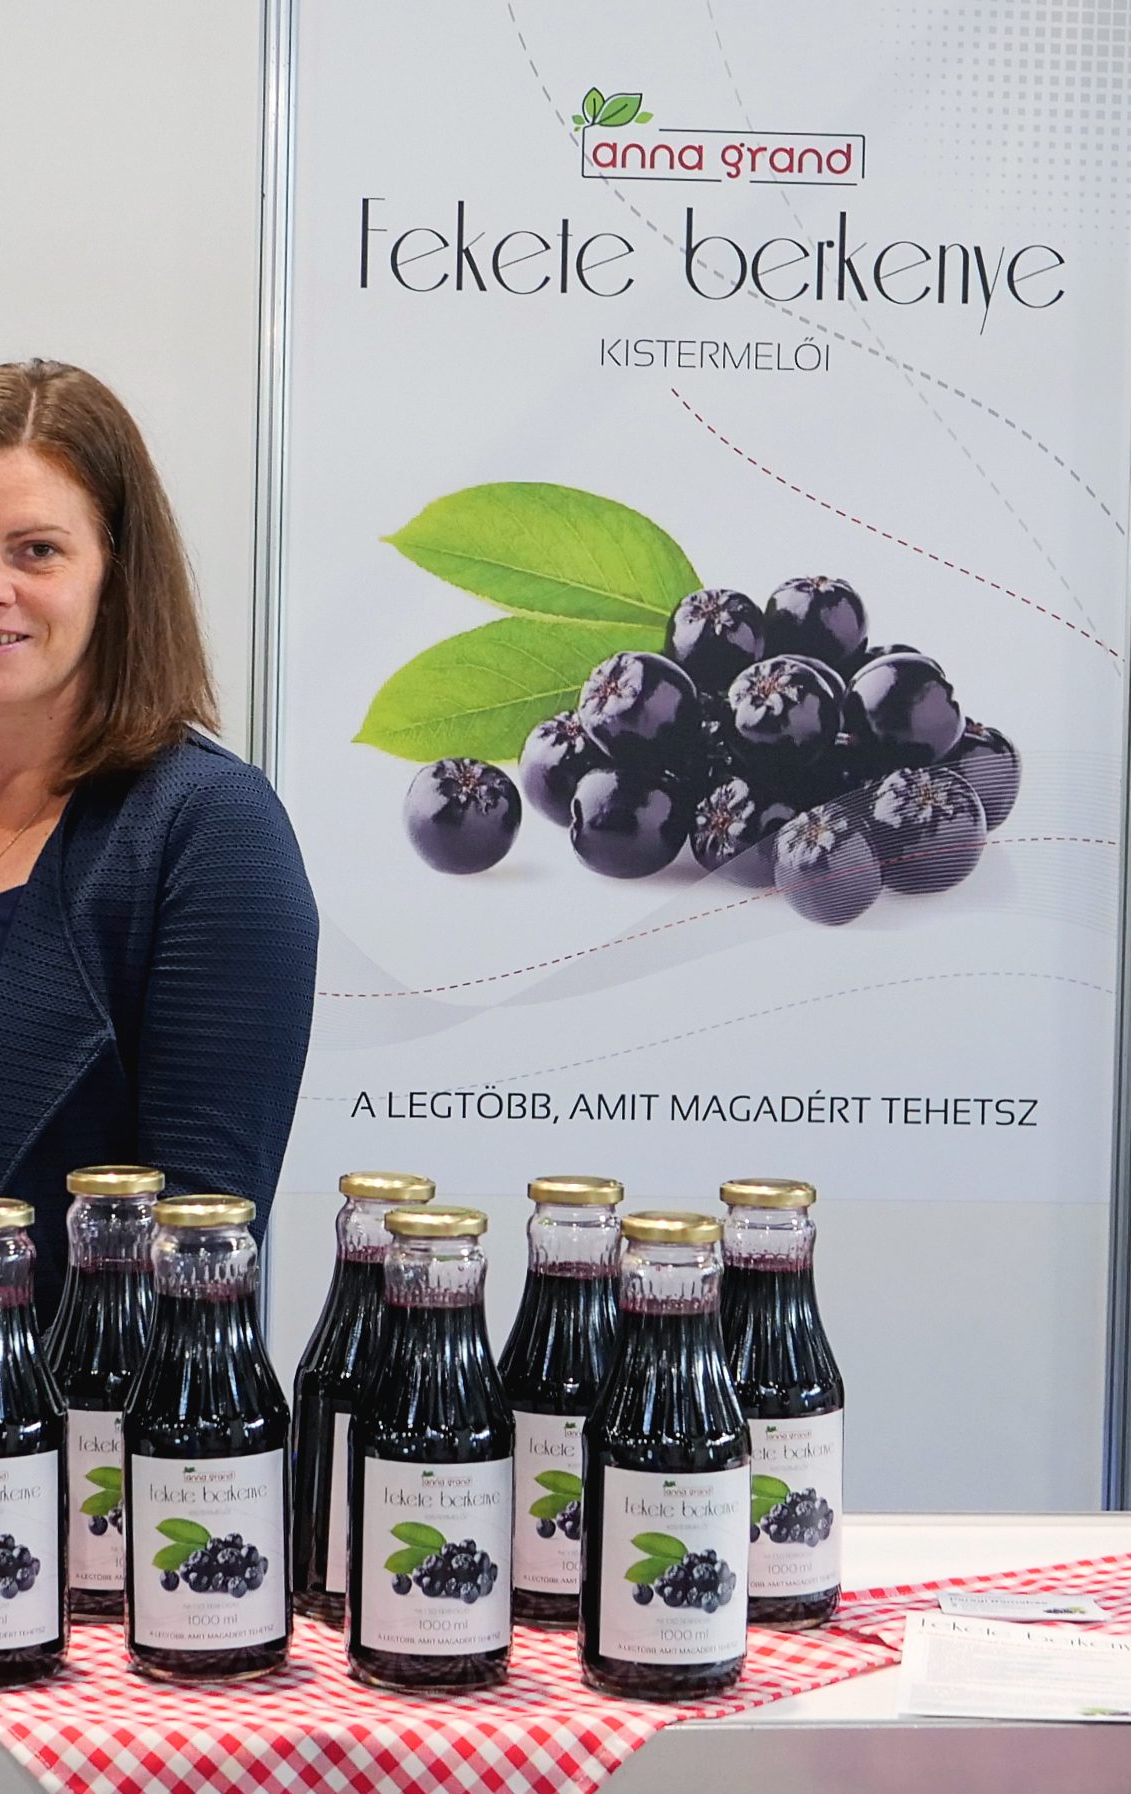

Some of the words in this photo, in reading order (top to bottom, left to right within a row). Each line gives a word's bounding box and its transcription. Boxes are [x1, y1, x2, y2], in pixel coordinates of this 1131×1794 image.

[591, 141, 704, 172] anna
[720, 141, 853, 181] grand
[360, 197, 636, 298] Fekete
[685, 207, 1066, 336] berkenye
[600, 336, 831, 373] KISTERMELŐI
[350, 1091, 377, 1119] A
[387, 1084, 561, 1126] LEGTÖBB,
[568, 1093, 661, 1123] AMIT
[670, 1088, 871, 1125] MAGADÉRT
[881, 1098, 1040, 1128] TEHETSZ
[768, 1562, 798, 1574] 1000
[799, 1561, 812, 1572] ml
[188, 1615, 220, 1627] 1000
[223, 1614, 238, 1625] ml
[419, 1620, 451, 1631] 1000
[453, 1619, 468, 1630] ml
[660, 1629, 693, 1640] 1000
[695, 1628, 709, 1639] ml
